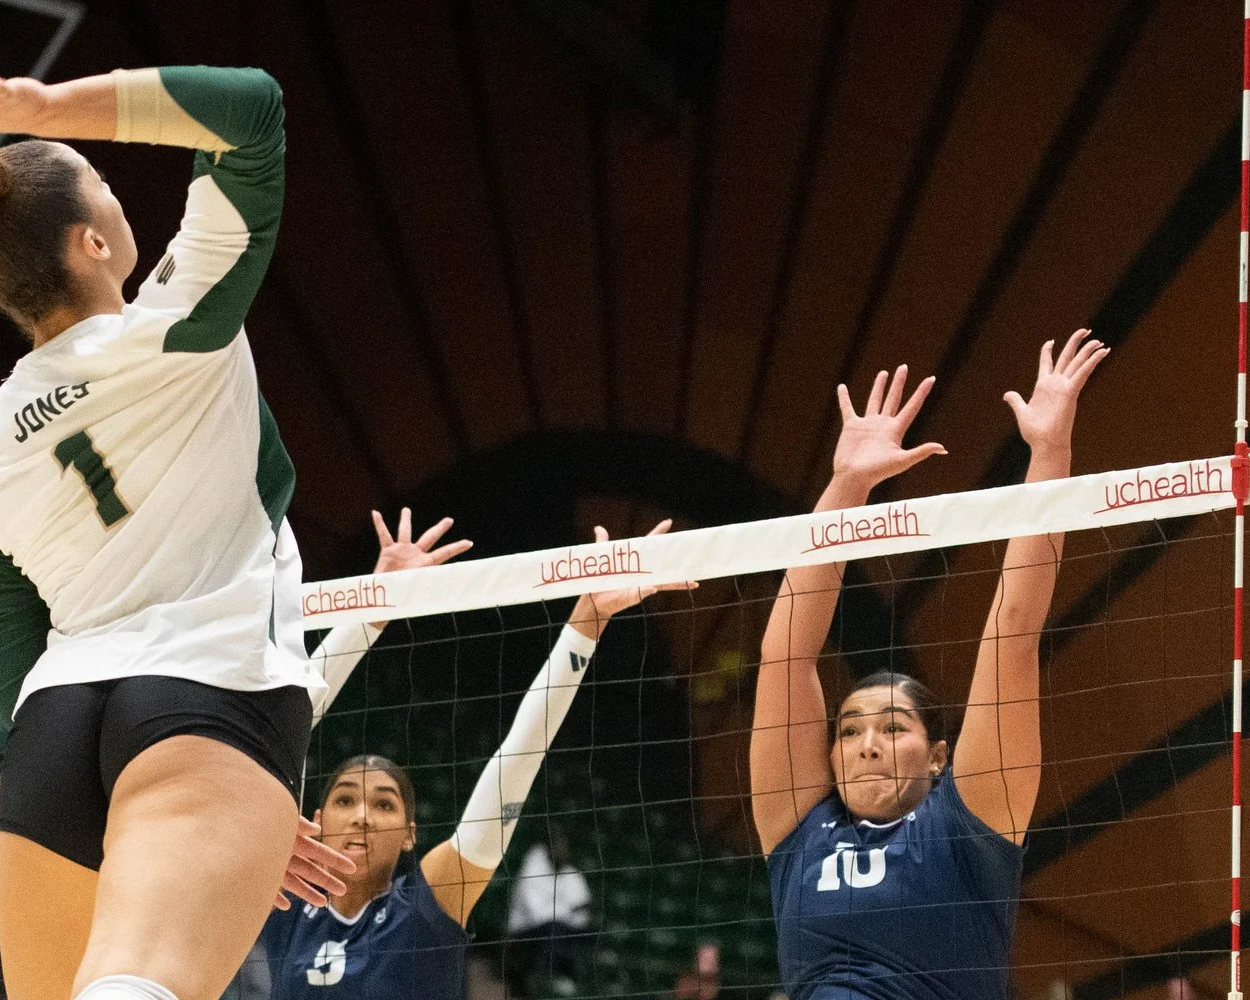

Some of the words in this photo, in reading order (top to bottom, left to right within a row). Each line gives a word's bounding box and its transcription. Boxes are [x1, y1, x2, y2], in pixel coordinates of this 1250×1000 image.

[51, 430, 134, 532] 1
[1105, 461, 1223, 509] uchealth
[811, 503, 919, 547] uchealth
[541, 542, 640, 582] uchealth
[817, 841, 889, 892] 10
